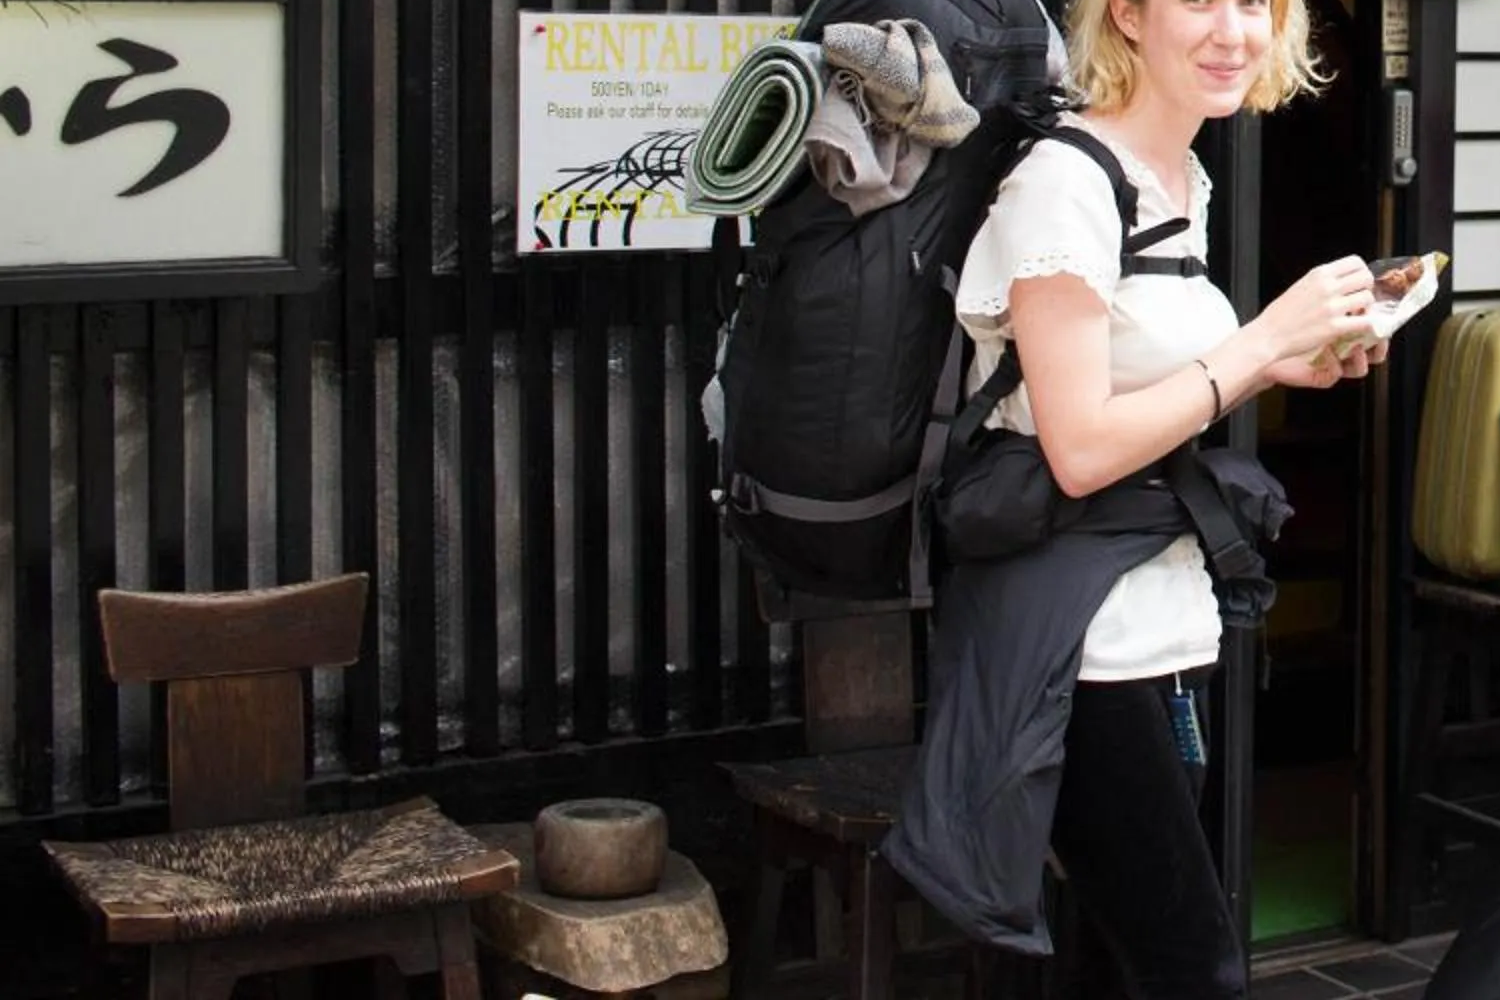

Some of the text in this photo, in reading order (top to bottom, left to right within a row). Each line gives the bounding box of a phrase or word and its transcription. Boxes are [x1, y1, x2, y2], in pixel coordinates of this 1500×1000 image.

[545, 20, 708, 73] RENTAL
[0, 37, 231, 198] ら
[547, 102, 583, 119] Please
[587, 102, 605, 119] ask
[608, 106, 627, 119] our
[629, 102, 656, 119] staff
[656, 102, 673, 119] for
[540, 190, 702, 221] RENTA
